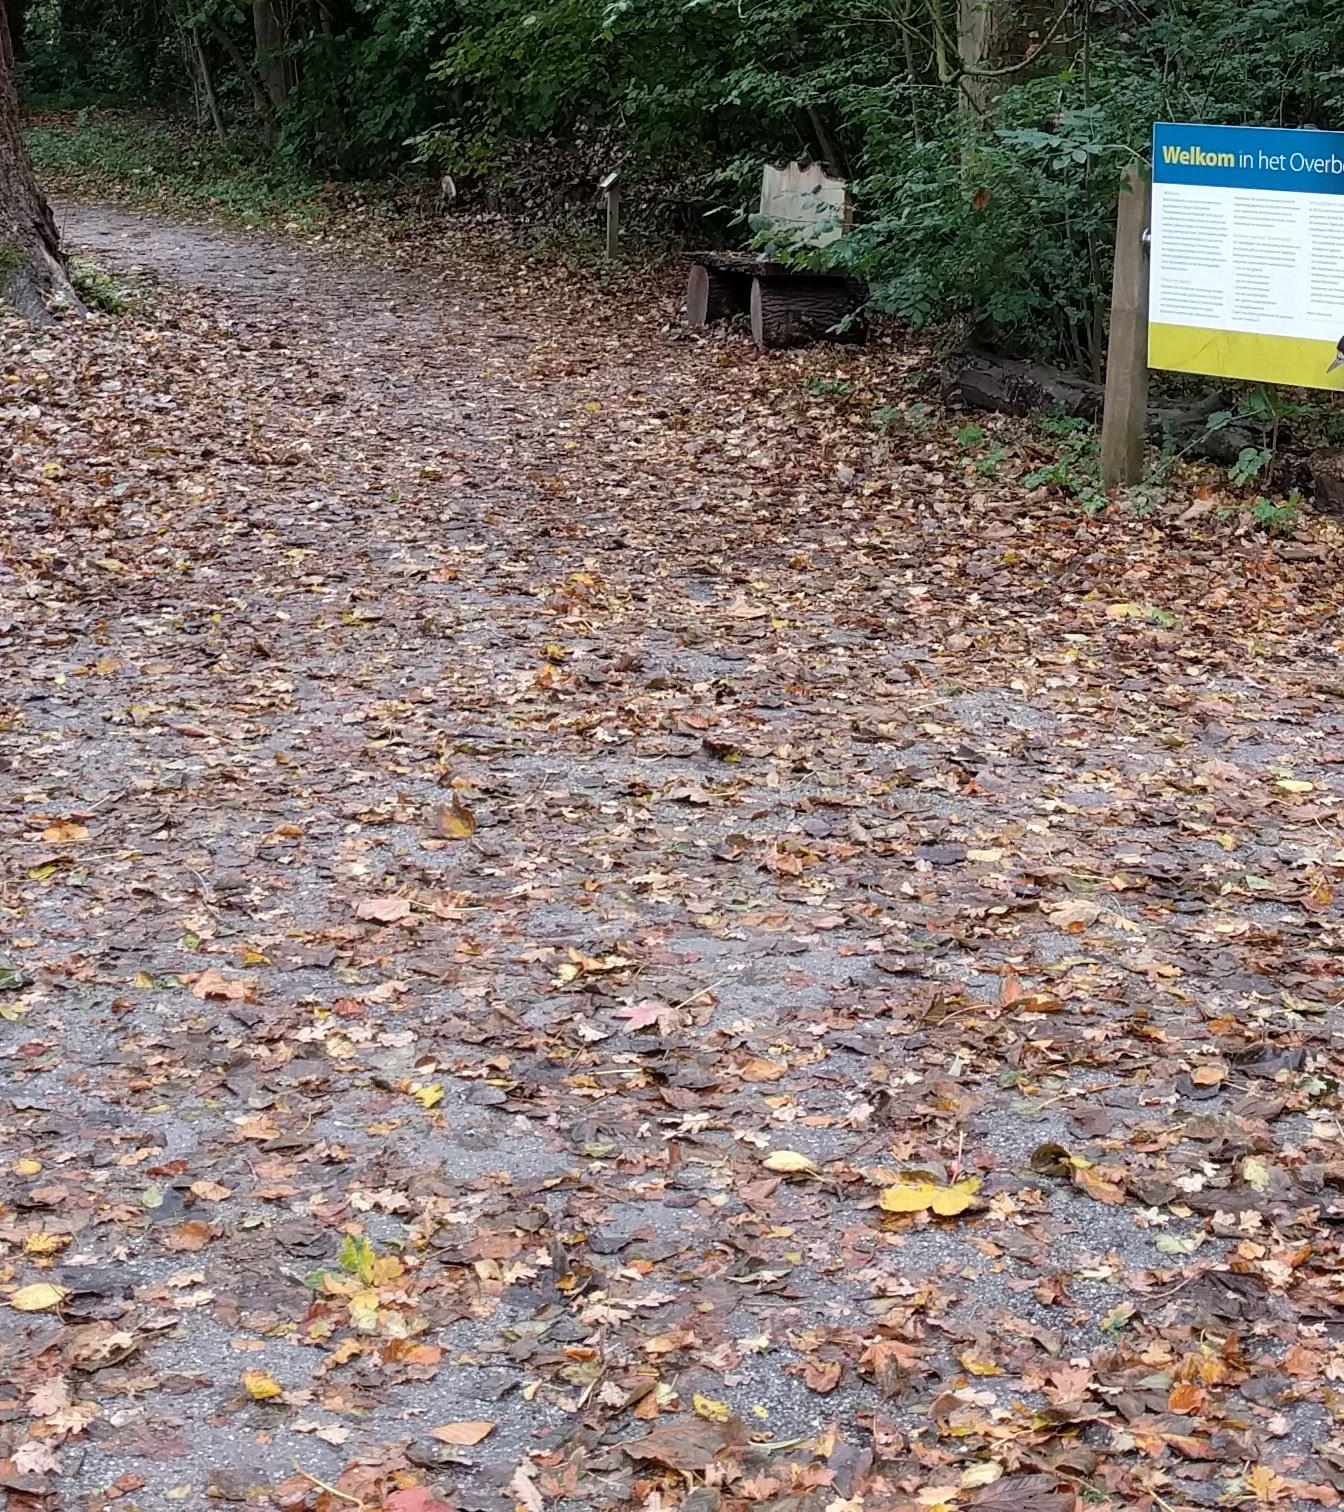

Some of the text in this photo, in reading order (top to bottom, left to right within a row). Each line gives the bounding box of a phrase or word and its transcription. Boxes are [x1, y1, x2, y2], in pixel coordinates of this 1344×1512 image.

[1162, 145, 1235, 168] Welkom
[1238, 149, 1254, 169] in
[1258, 150, 1287, 171] het
